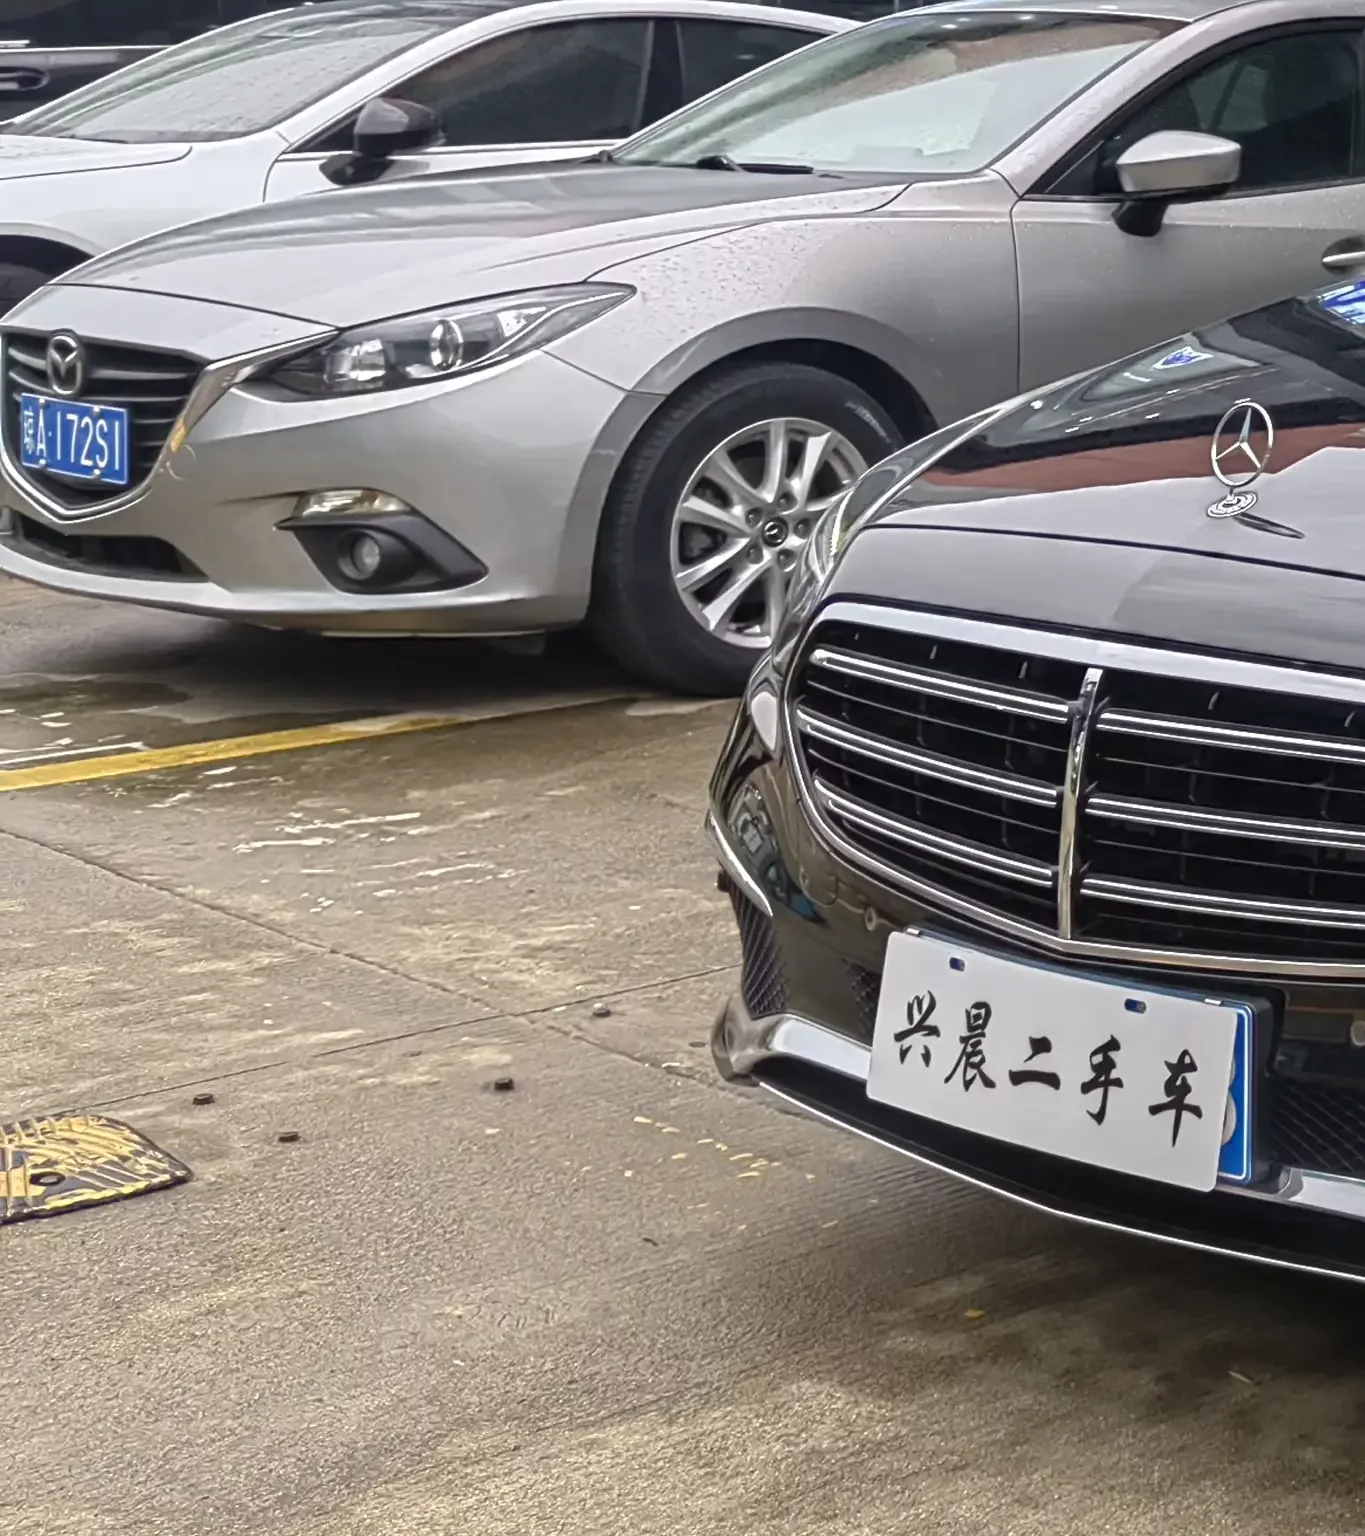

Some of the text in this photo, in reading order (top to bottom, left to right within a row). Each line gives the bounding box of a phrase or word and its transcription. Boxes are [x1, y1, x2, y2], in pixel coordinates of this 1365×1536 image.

[893, 989, 1203, 1149] 兴晨二手车
